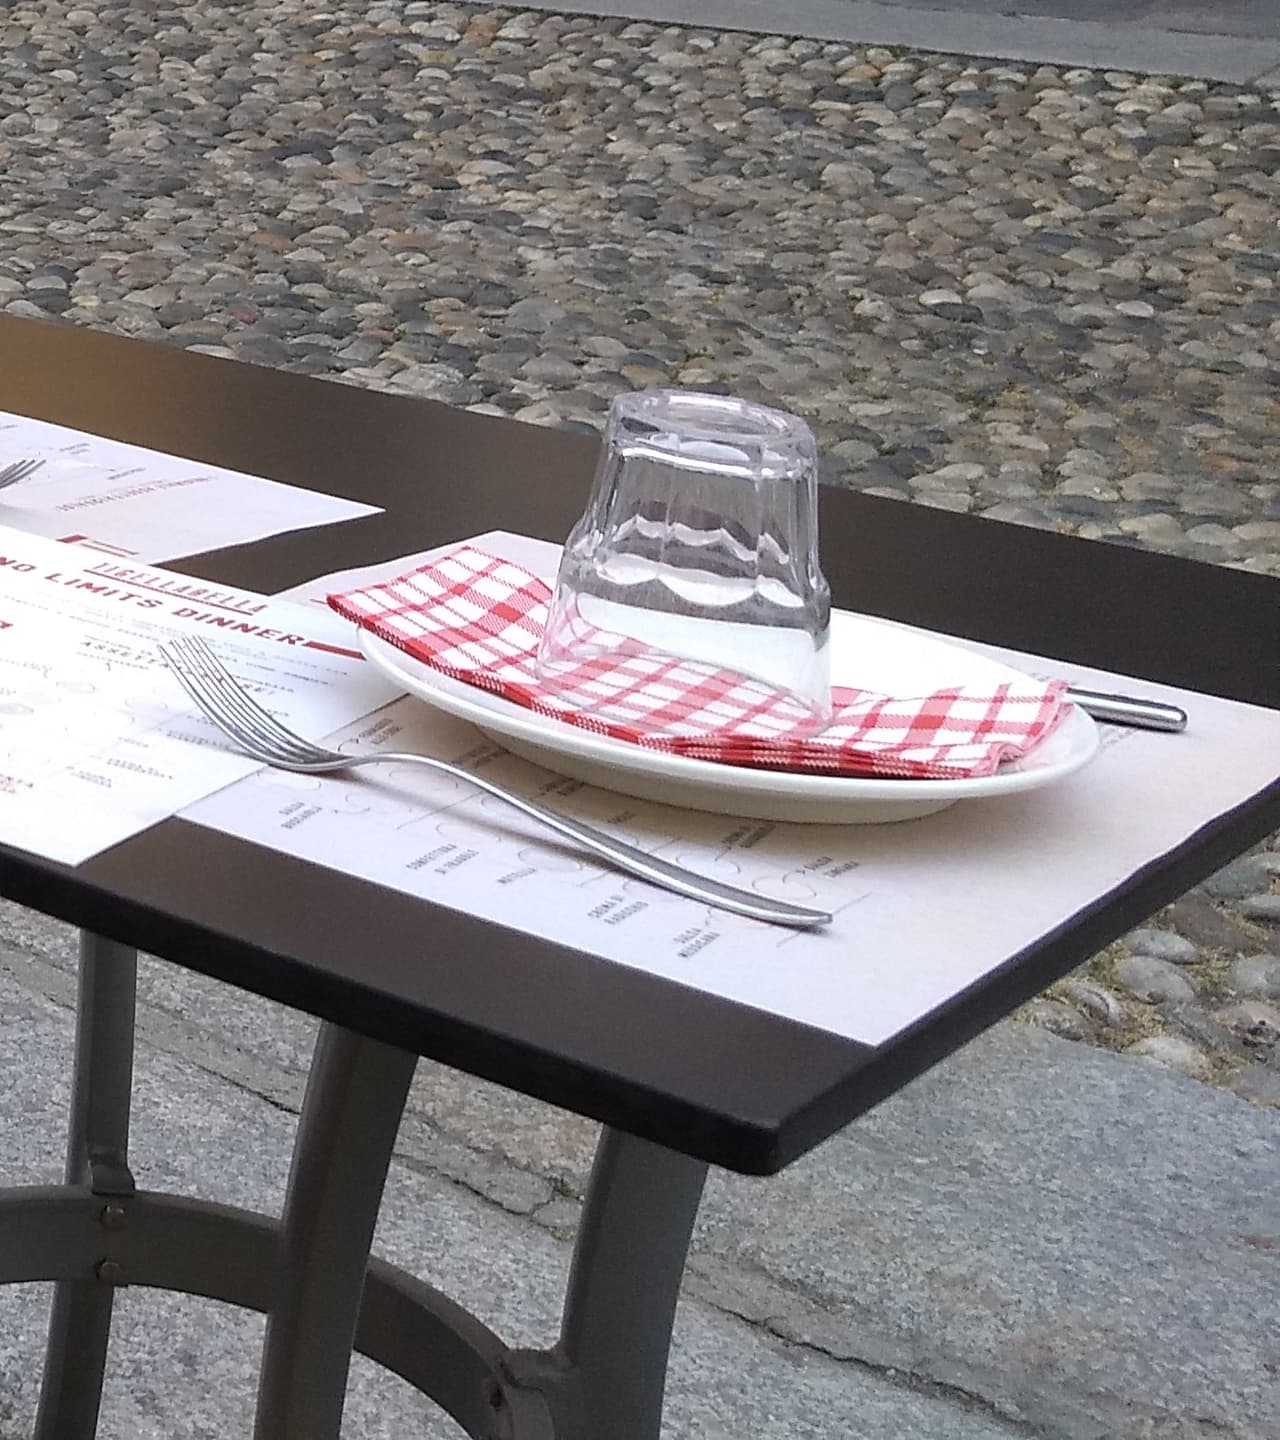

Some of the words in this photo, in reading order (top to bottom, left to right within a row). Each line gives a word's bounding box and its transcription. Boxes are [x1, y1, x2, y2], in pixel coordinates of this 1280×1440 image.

[45, 572, 164, 609] LIMITS
[171, 607, 306, 646] DINNER
[91, 561, 269, 613] TIGELLABELLA
